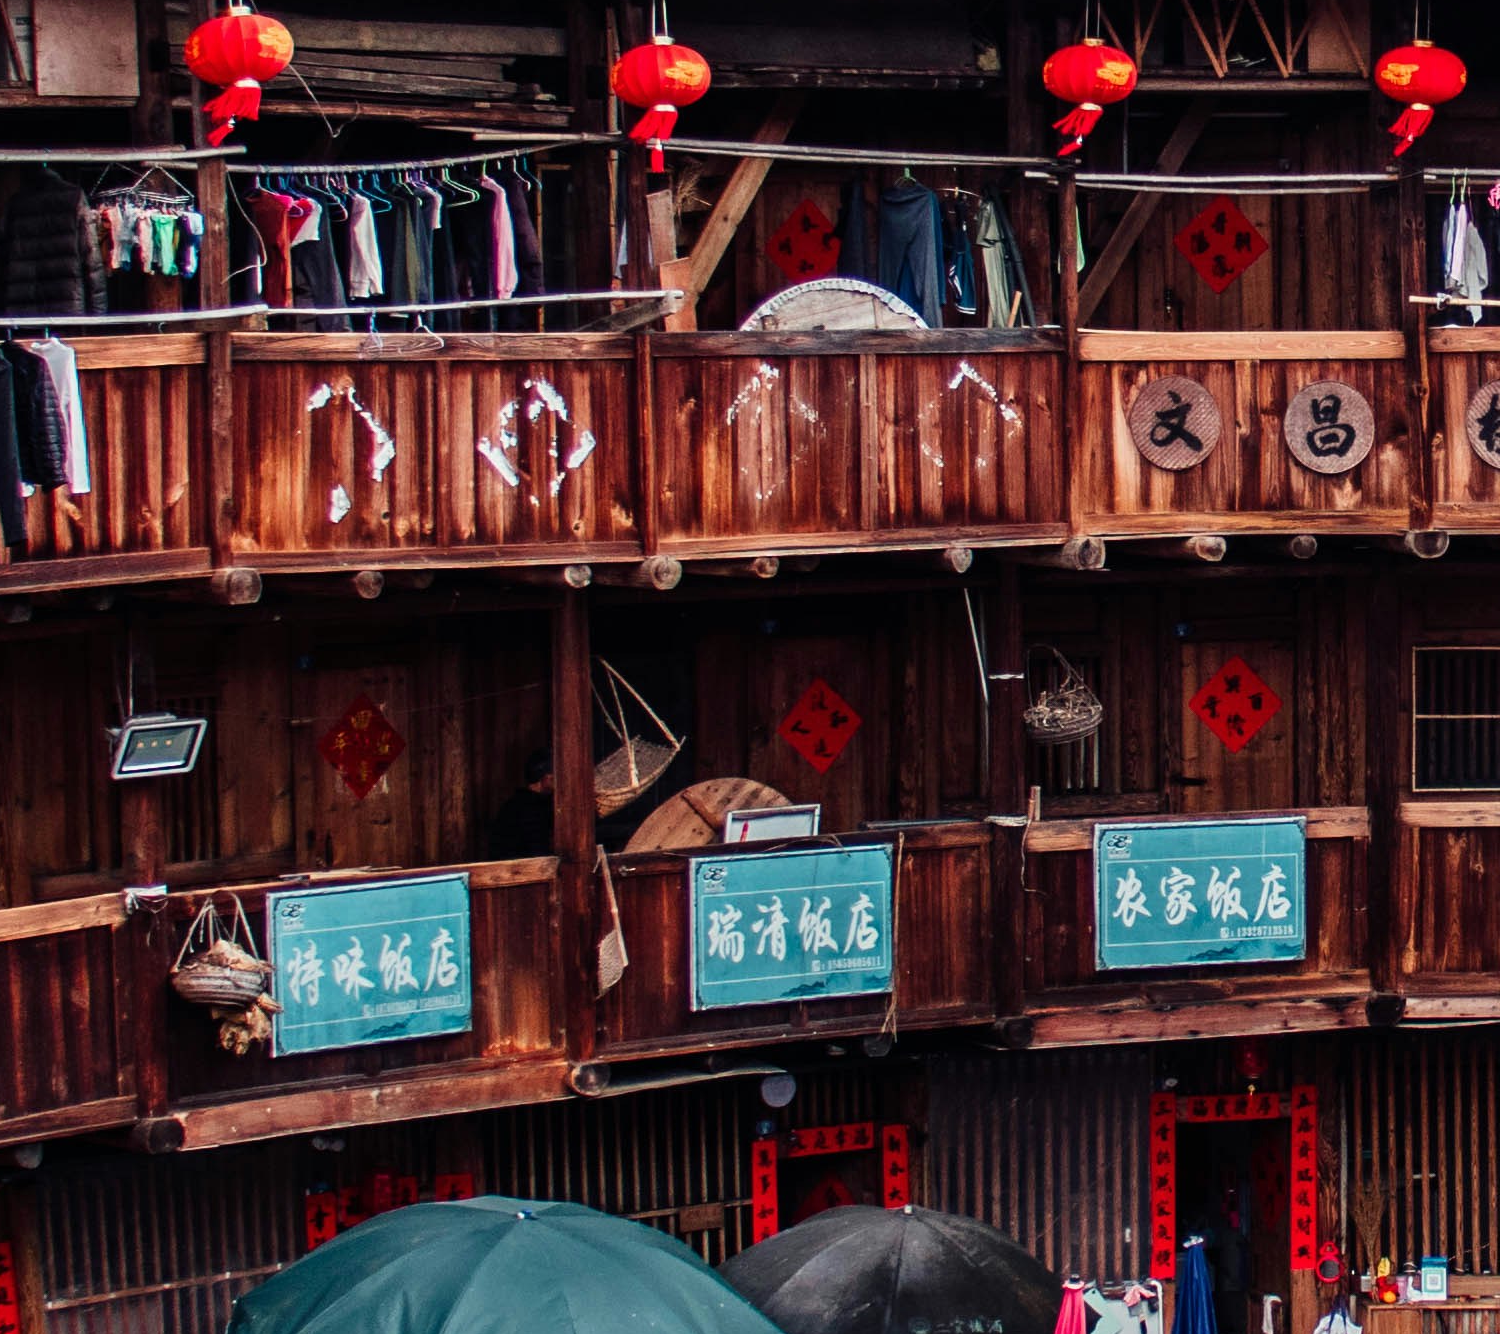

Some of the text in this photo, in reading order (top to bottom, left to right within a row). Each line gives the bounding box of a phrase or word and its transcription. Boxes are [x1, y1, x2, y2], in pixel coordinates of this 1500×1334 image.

[708, 892, 879, 963] 瑞清饭店
[1113, 863, 1292, 927] 农家饭店
[287, 926, 460, 1007] 特味饭店
